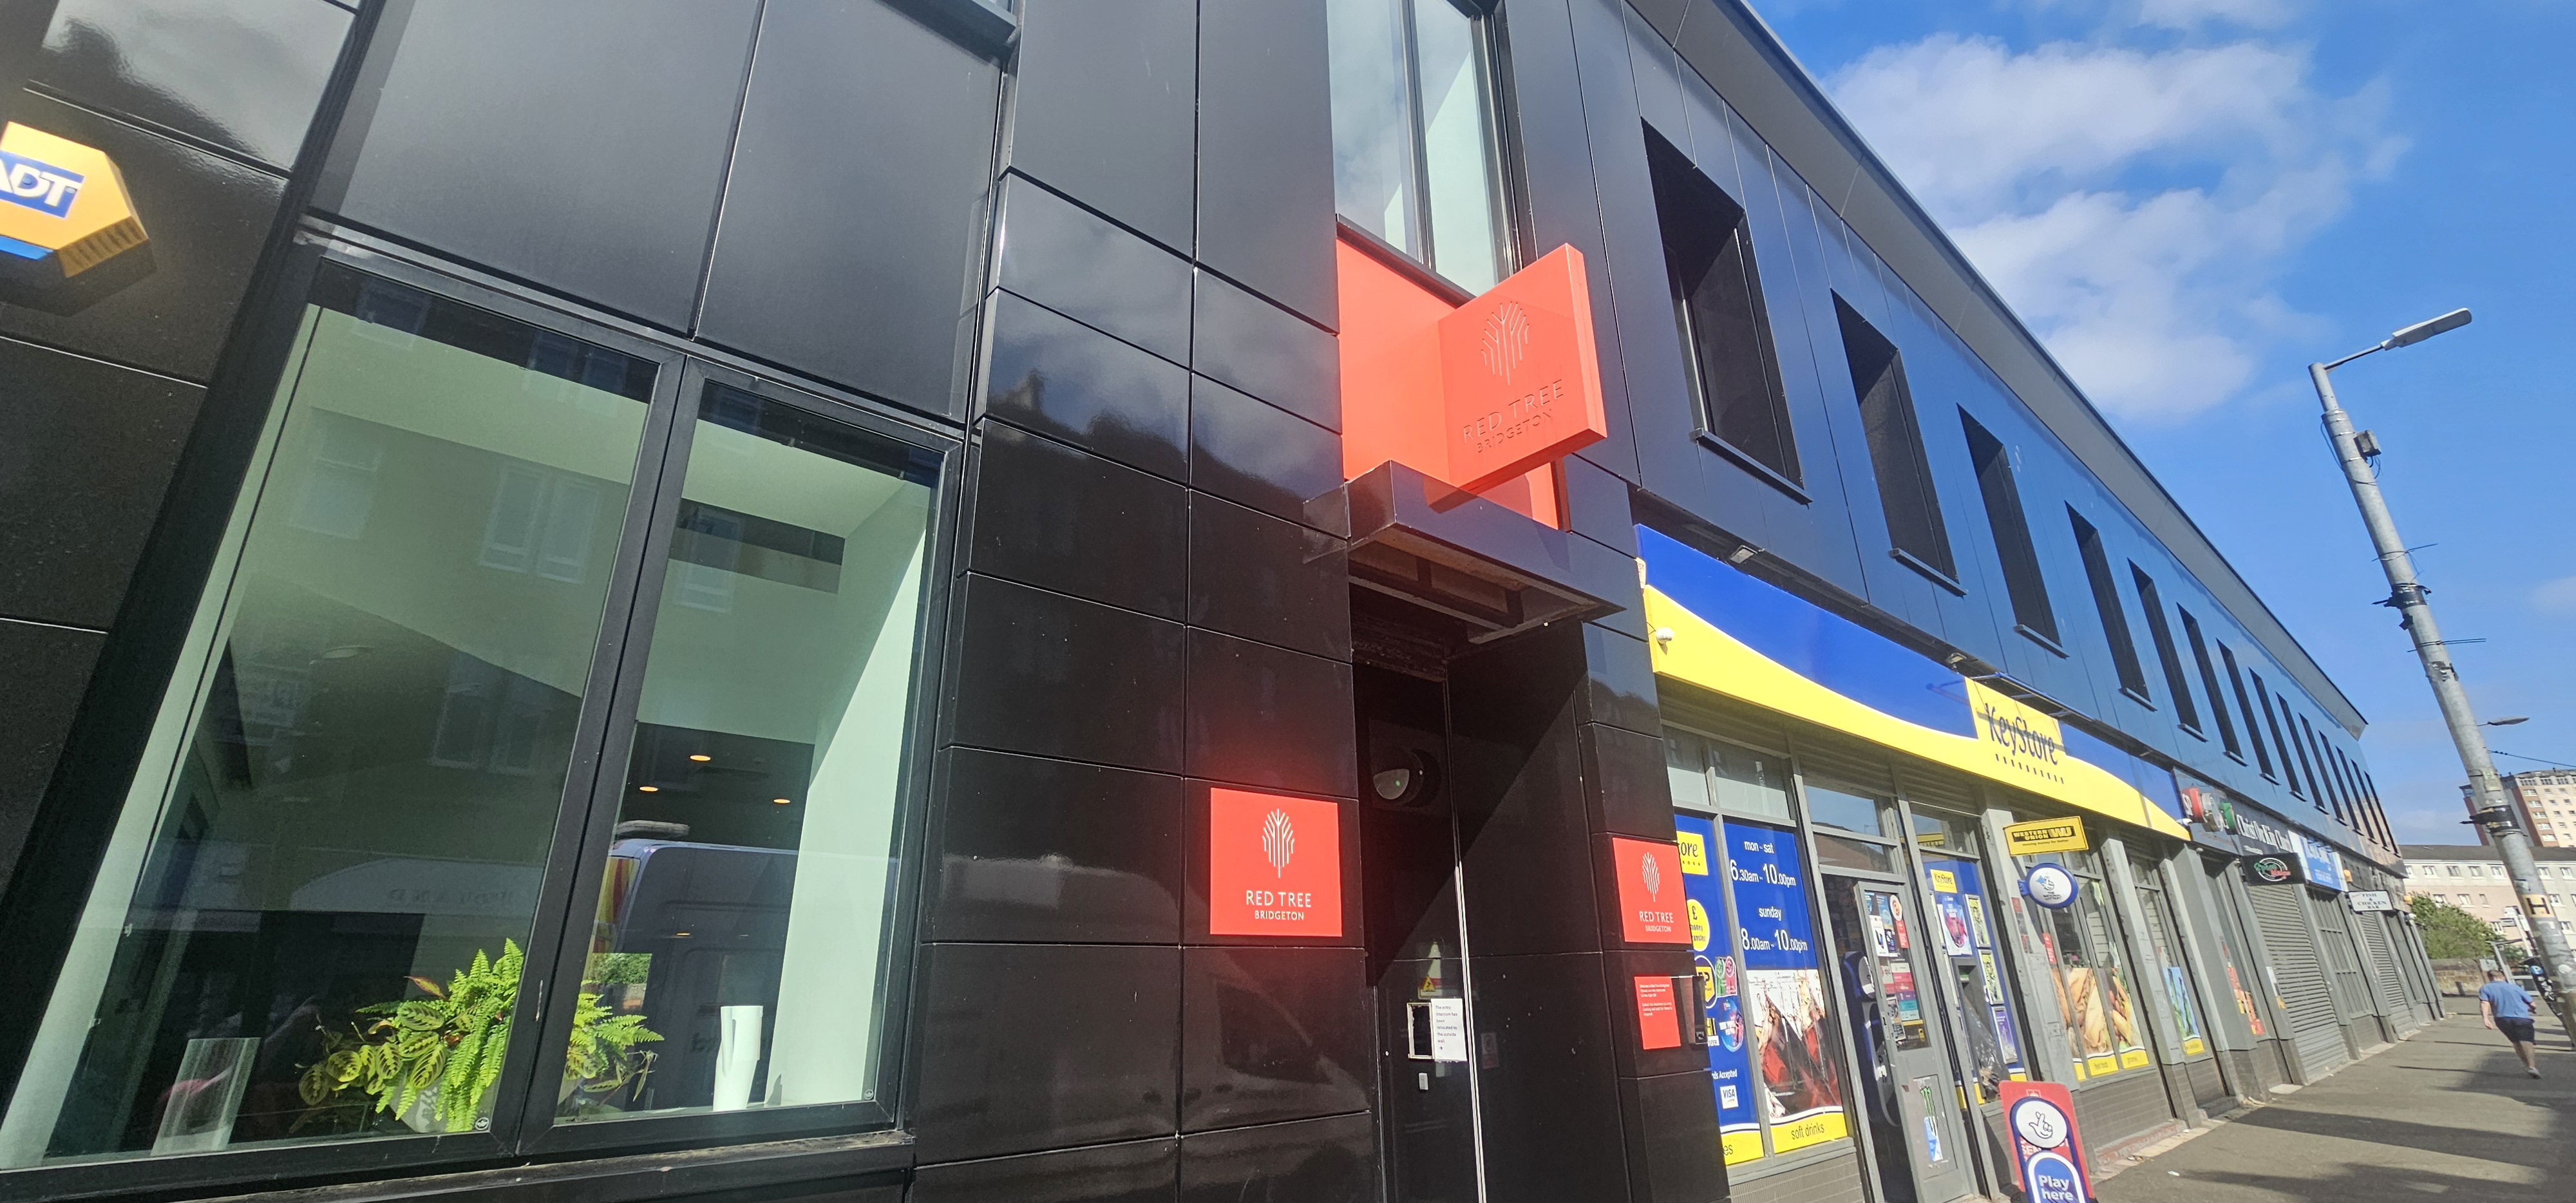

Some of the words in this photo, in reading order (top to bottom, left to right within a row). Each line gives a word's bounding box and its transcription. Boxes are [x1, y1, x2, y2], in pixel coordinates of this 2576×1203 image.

[1463, 411, 1502, 444] RED
[1508, 379, 1564, 419] TREE
[1476, 409, 1552, 453] BRIDGETON
[1985, 703, 2058, 766] KeyStore
[2013, 829, 2048, 838] WESTERN
[2048, 826, 2073, 838] WU
[1679, 842, 1698, 858] ore
[1744, 841, 1759, 852] mon
[1763, 842, 1774, 854] sat
[1730, 859, 1759, 882] 6.30am
[1763, 863, 1797, 888] 10.00pm
[1934, 873, 1953, 885] KeyStore
[1245, 890, 1274, 906] RED
[1278, 891, 1312, 907] TREE
[2527, 897, 2548, 915] H
[1255, 910, 1304, 921] BRIDGETON
[1639, 911, 1654, 922] RED
[1655, 911, 1674, 924] TREE
[1759, 906, 1781, 921] sunday
[1741, 927, 1771, 951] 8.00am
[1774, 929, 1808, 954] 10.00pm
[1719, 1068, 1738, 1080] Accepted
[1723, 1088, 1736, 1099] VISA
[1790, 1125, 1804, 1140] soft
[1805, 1122, 1825, 1136] drinks
[1723, 1144, 1734, 1156] es
[2038, 1175, 2070, 1191] Play
[2041, 1188, 2074, 1201] here
